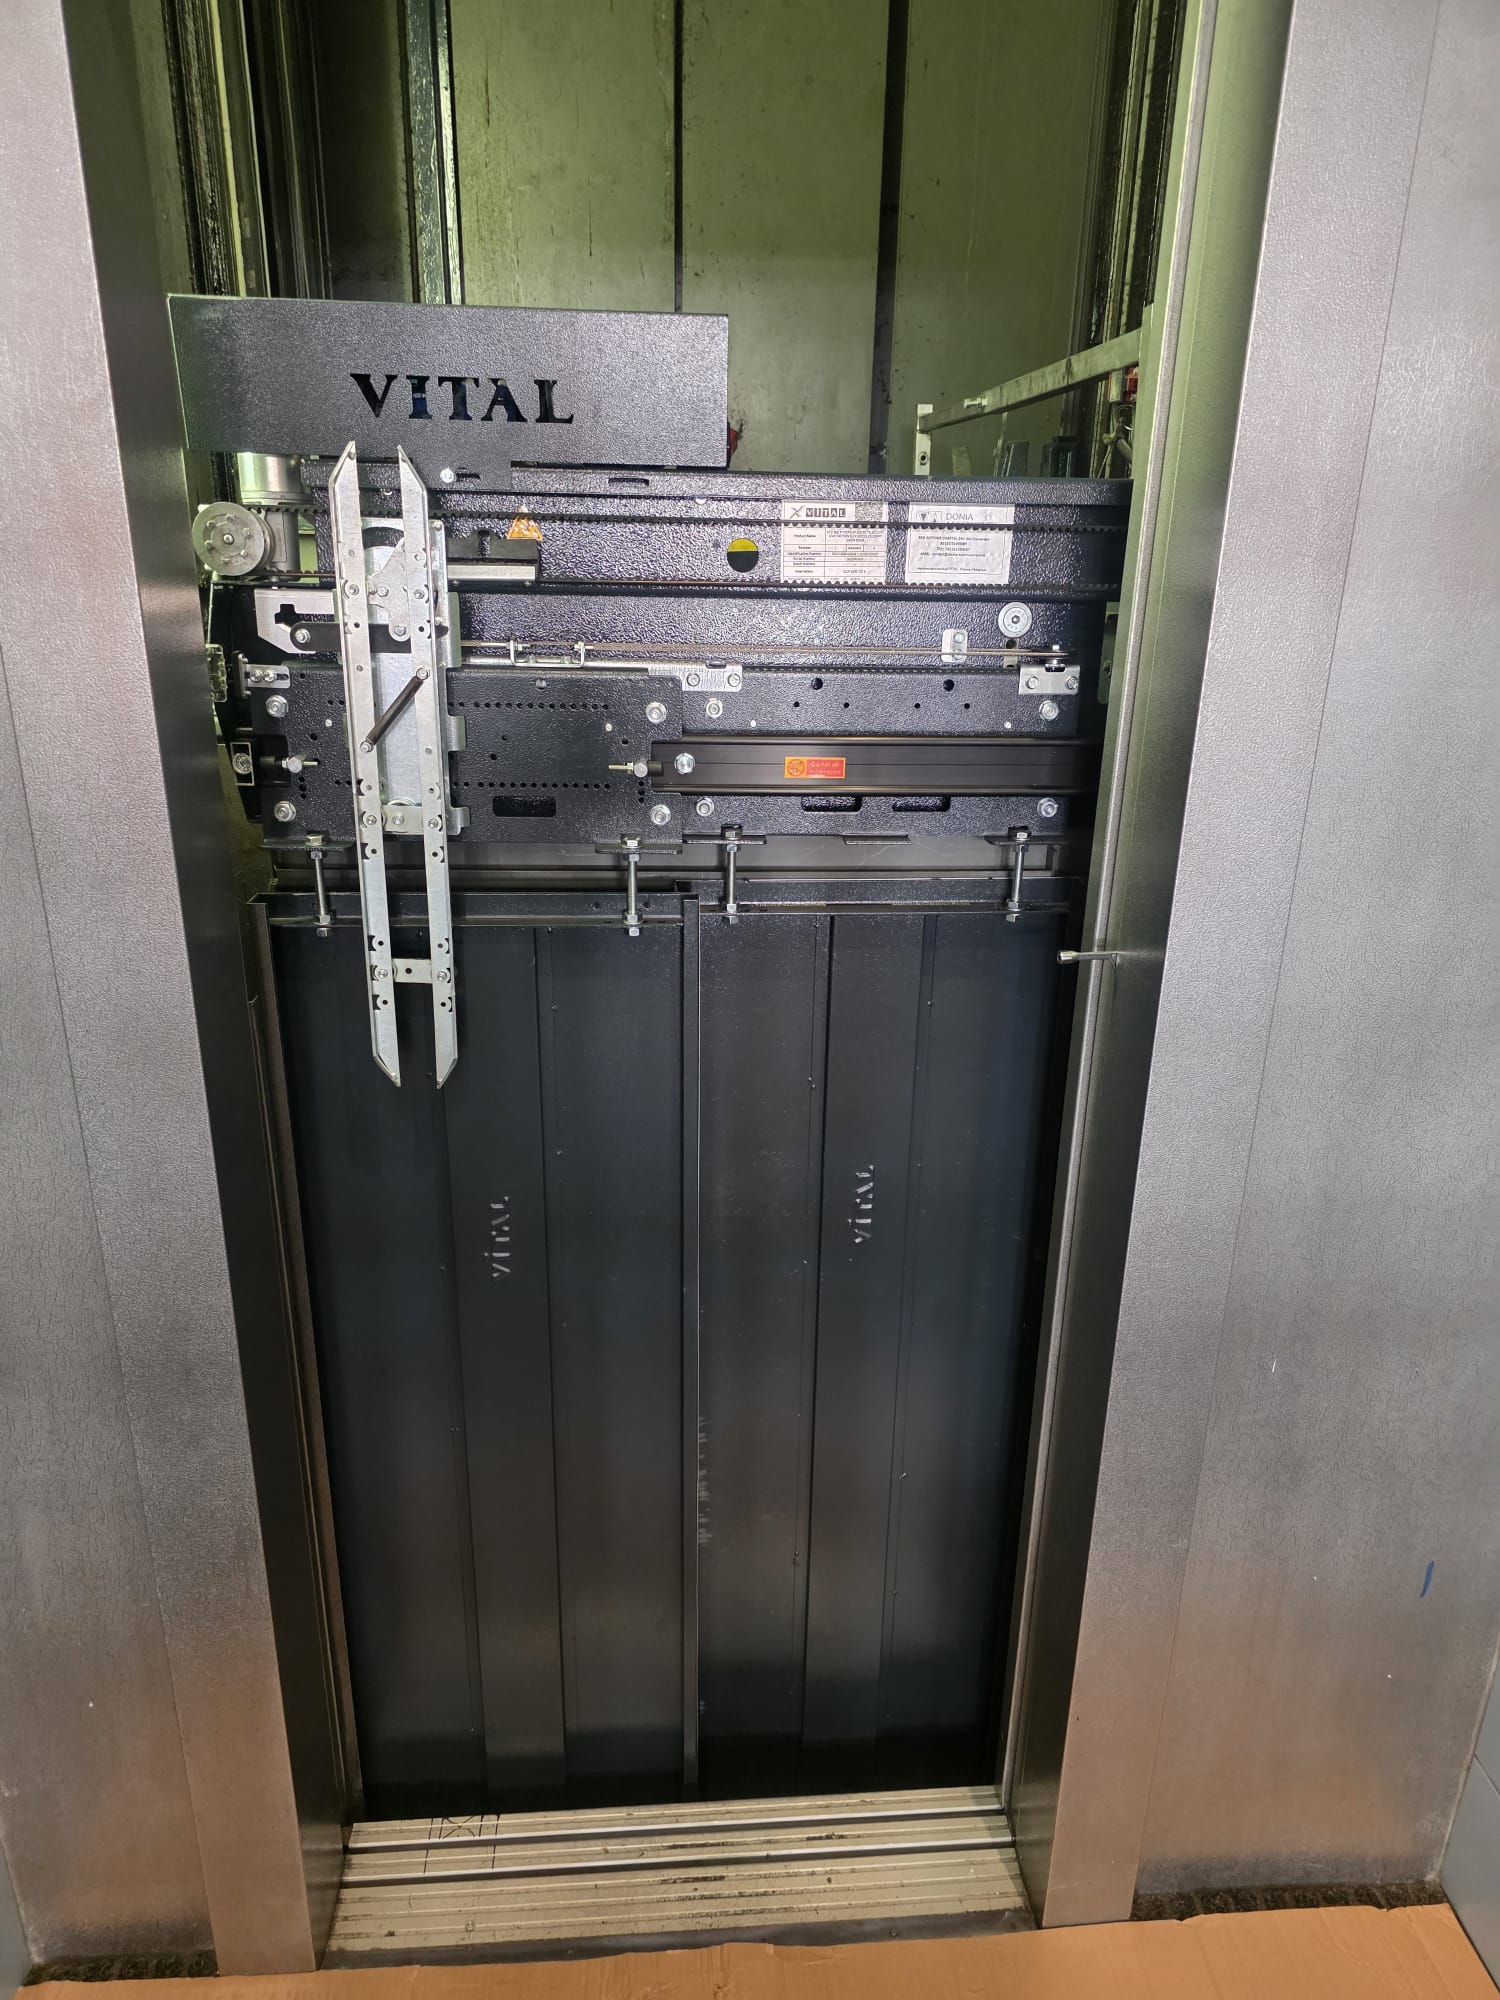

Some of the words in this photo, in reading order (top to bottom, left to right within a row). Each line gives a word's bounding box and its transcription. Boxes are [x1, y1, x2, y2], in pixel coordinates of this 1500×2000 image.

[349, 372, 575, 424] VITAL
[805, 507, 847, 518] VITAL
[945, 512, 975, 522] DONIA
